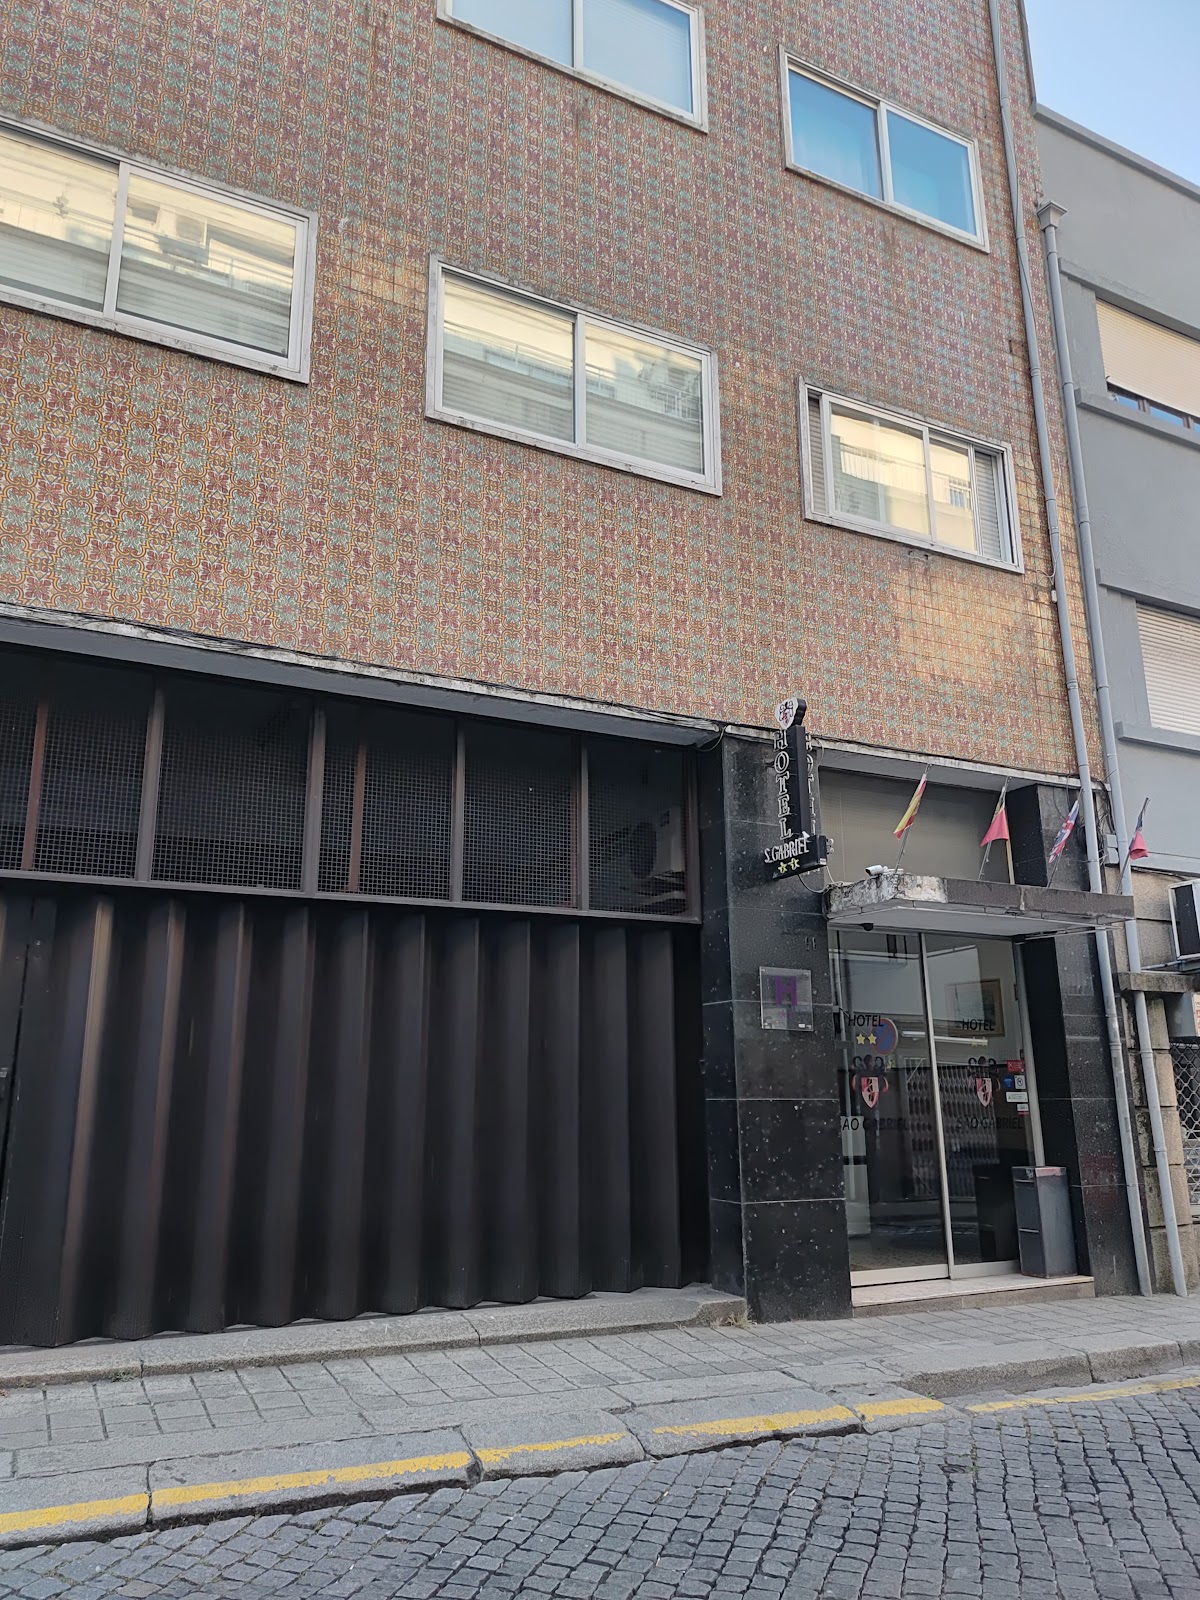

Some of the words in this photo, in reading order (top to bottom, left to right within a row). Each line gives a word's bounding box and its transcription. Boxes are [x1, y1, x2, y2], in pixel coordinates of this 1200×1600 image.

[772, 729, 793, 840] HOTEL
[774, 975, 798, 1006] H
[848, 1014, 884, 1027] HOTEL
[962, 1018, 995, 1031] HOTEL
